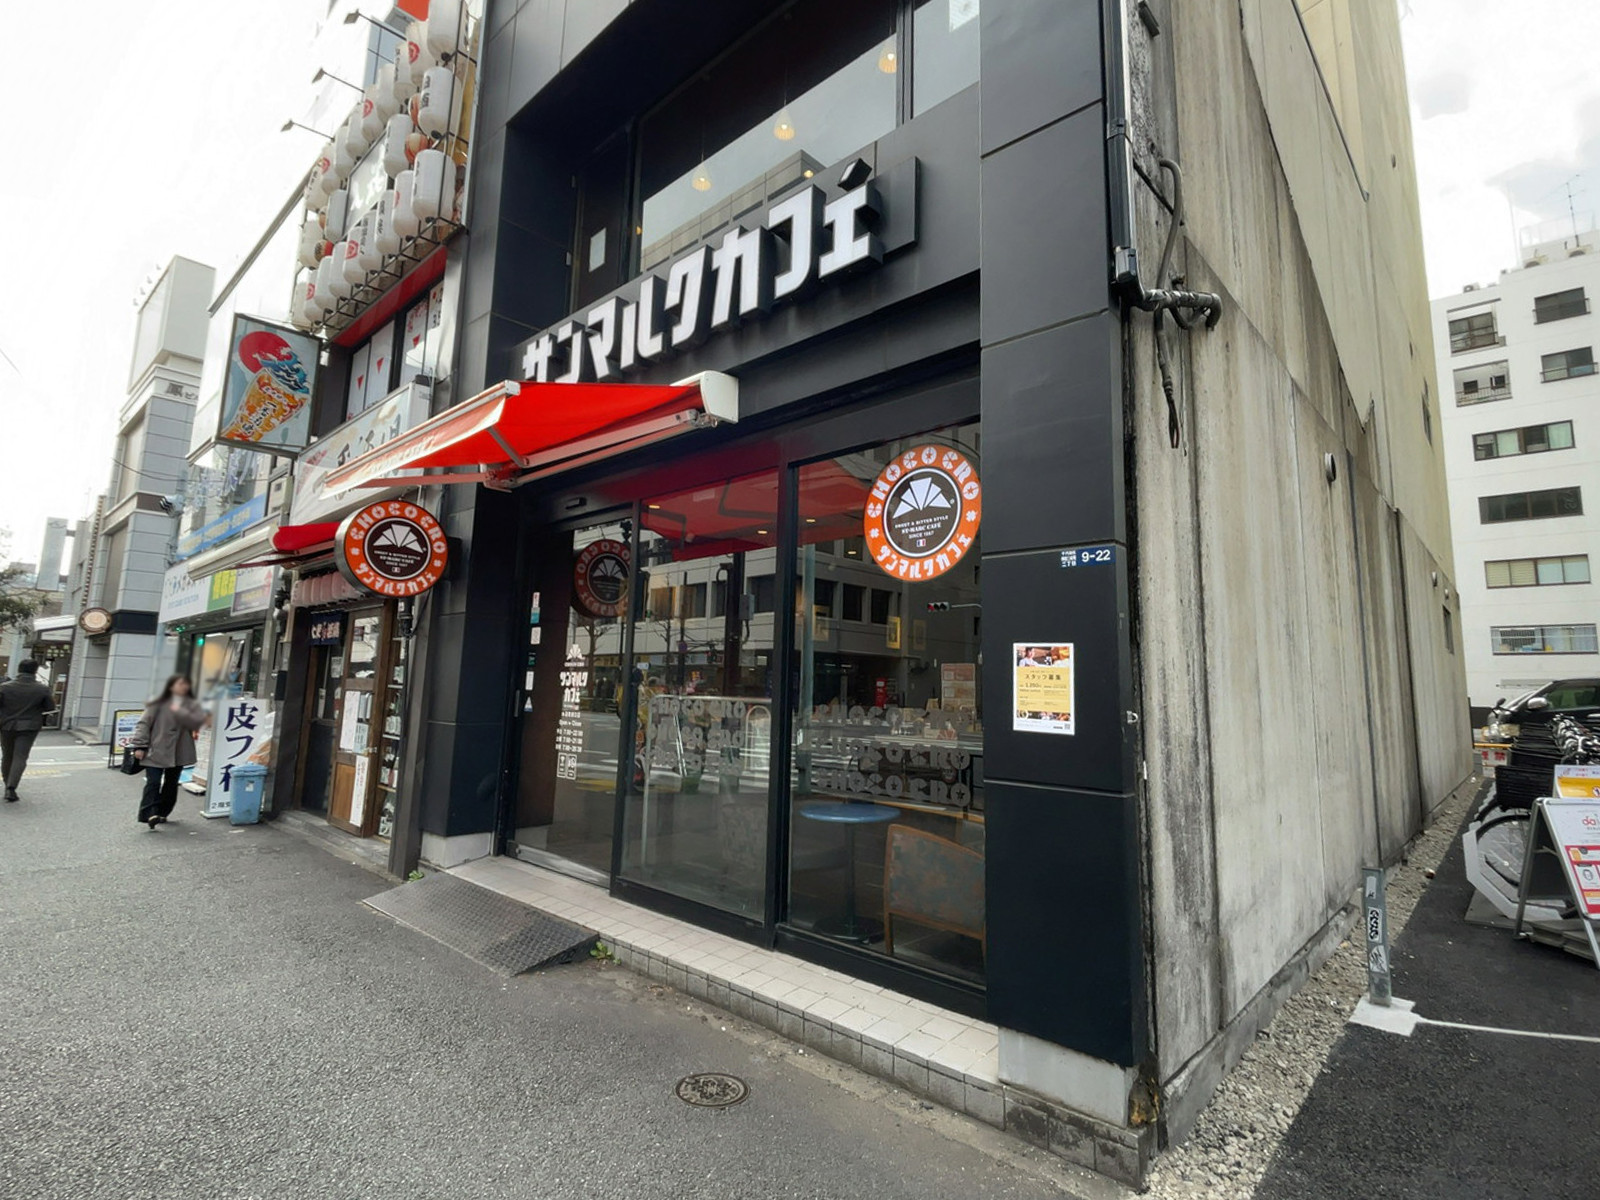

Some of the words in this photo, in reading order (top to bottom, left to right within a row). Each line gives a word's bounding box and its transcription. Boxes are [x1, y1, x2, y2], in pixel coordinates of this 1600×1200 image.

[522, 158, 876, 383] サンマルクカフェ
[867, 446, 979, 518] CHOCOCRO
[350, 502, 446, 554] CHOCOCRO
[876, 532, 972, 579] サンマルクカフェ
[1081, 549, 1111, 563] 9-22
[564, 687, 580, 703] カフェ
